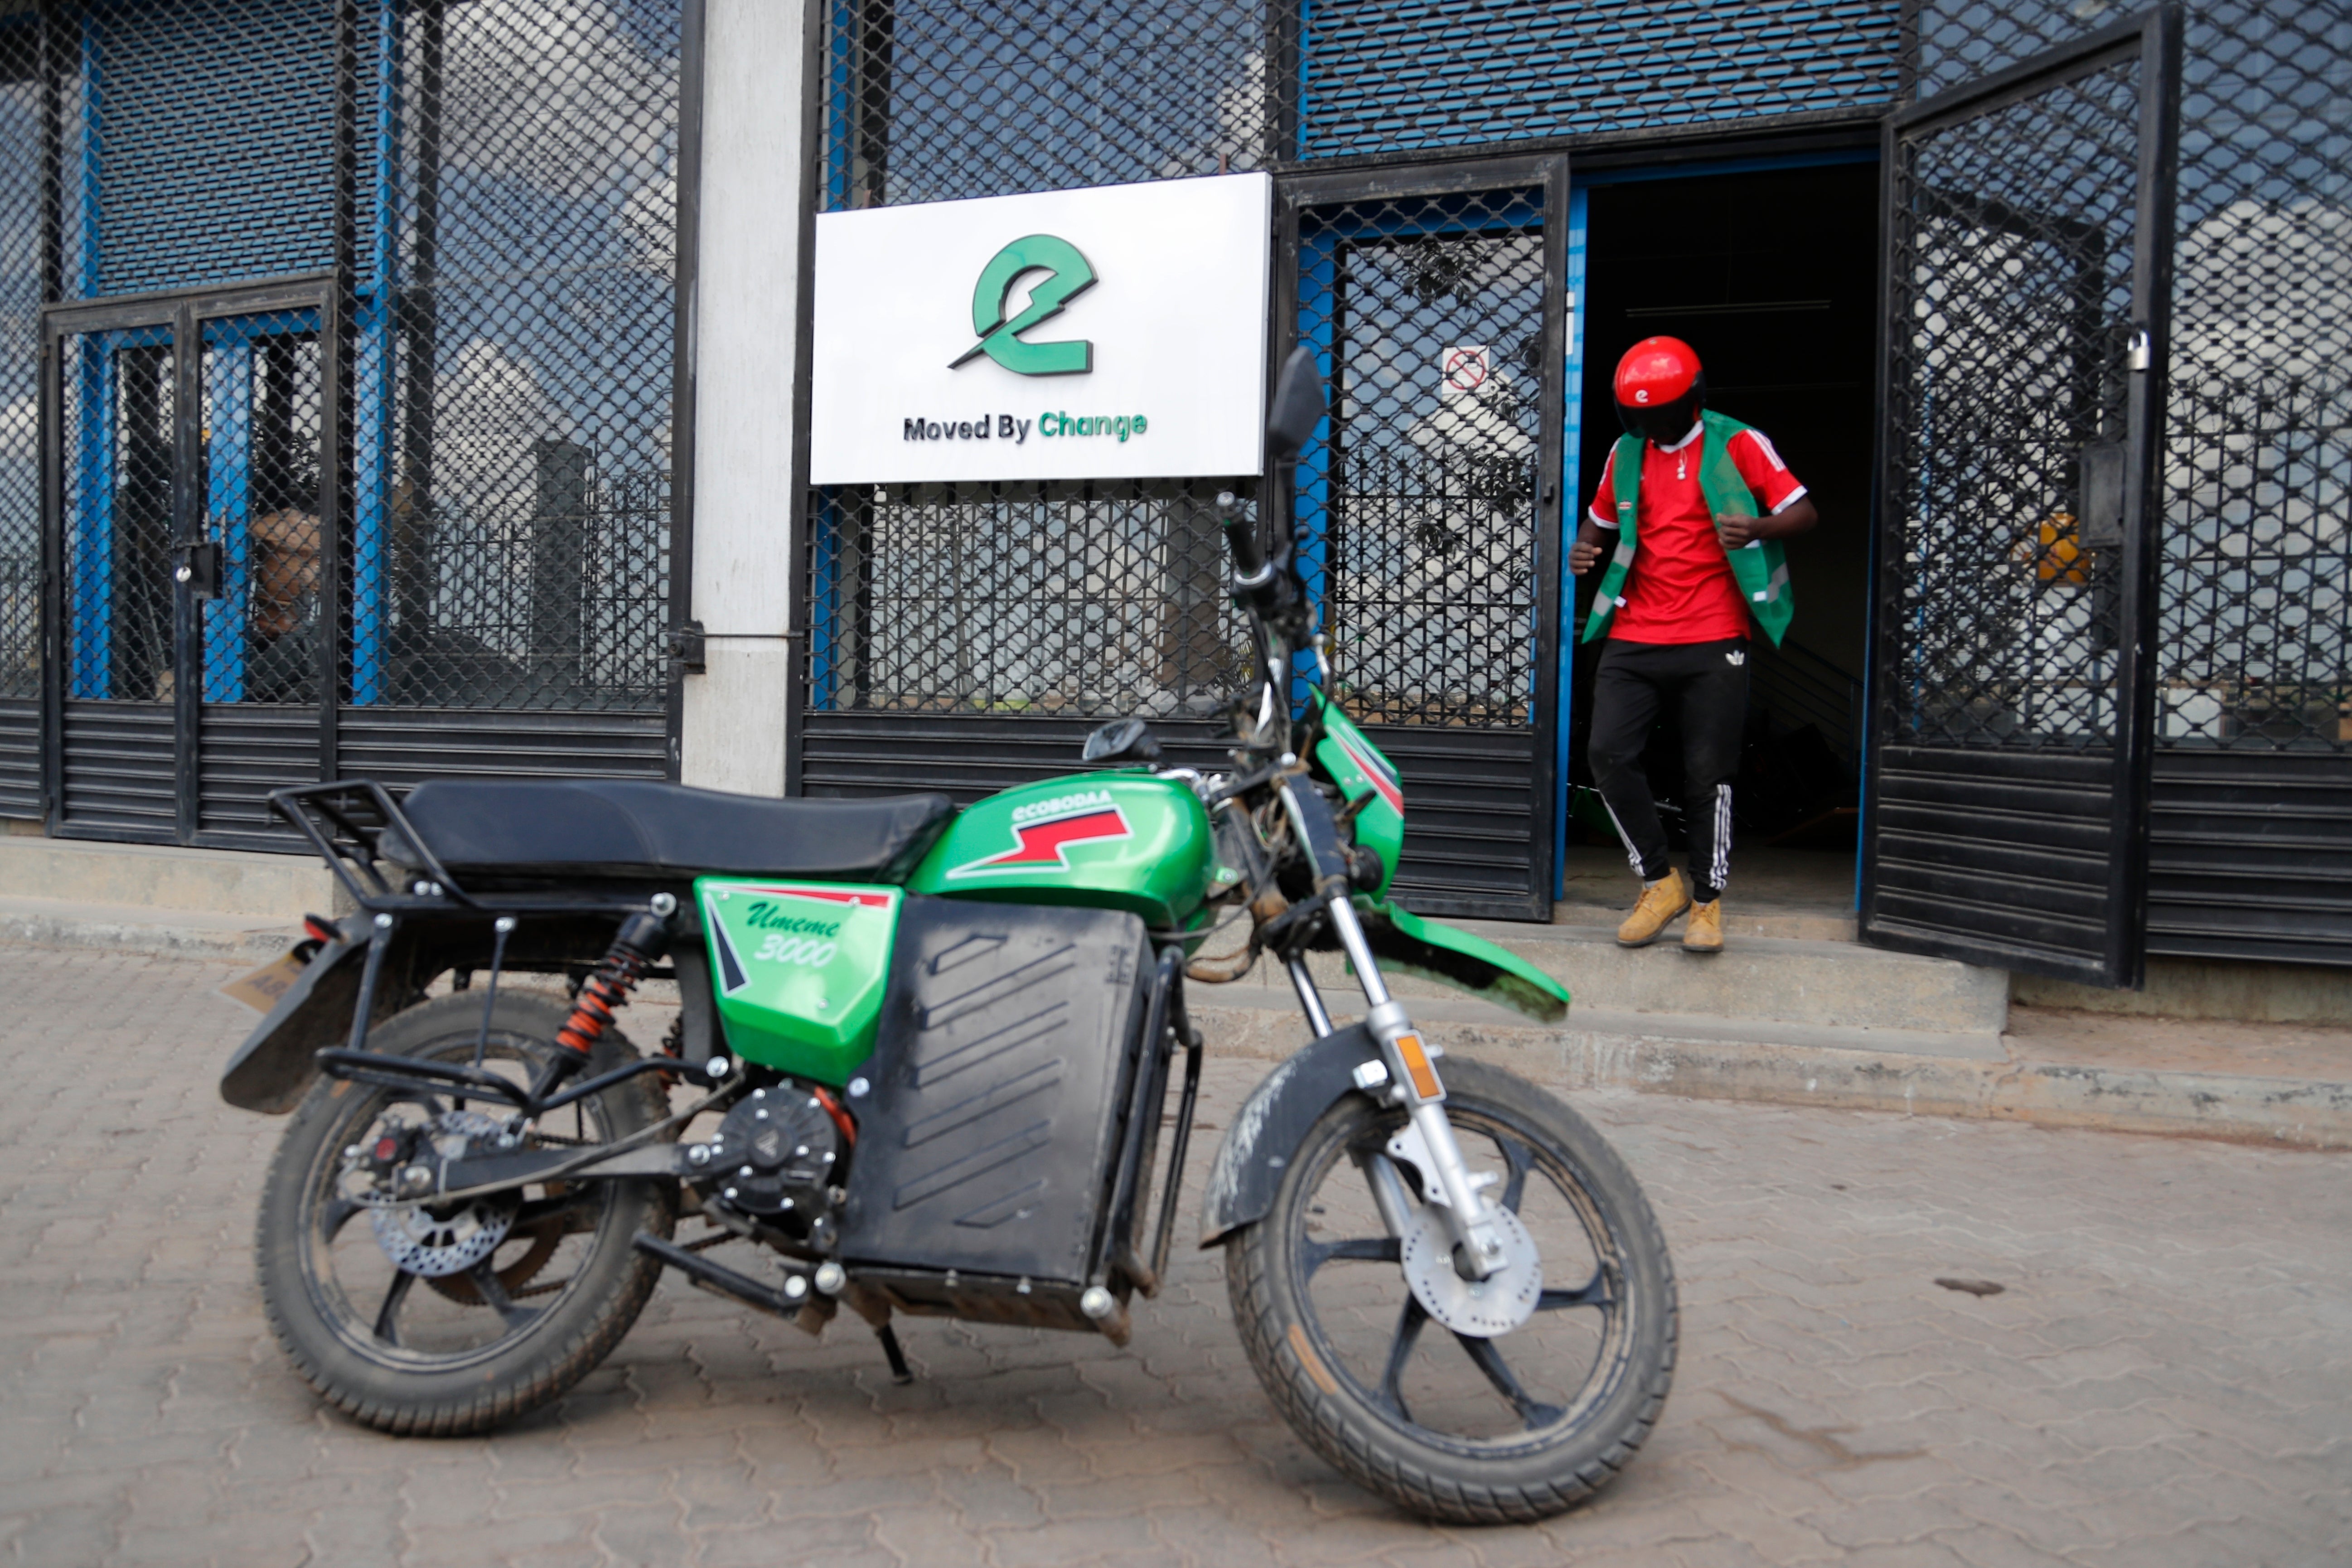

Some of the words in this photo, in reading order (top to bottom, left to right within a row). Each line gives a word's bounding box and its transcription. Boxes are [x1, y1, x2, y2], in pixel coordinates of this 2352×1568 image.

[904, 414, 990, 440] Moved
[998, 415, 1031, 444] By
[1038, 411, 1147, 442] Change
[747, 900, 840, 937] Umeme
[754, 934, 837, 968] 3000
